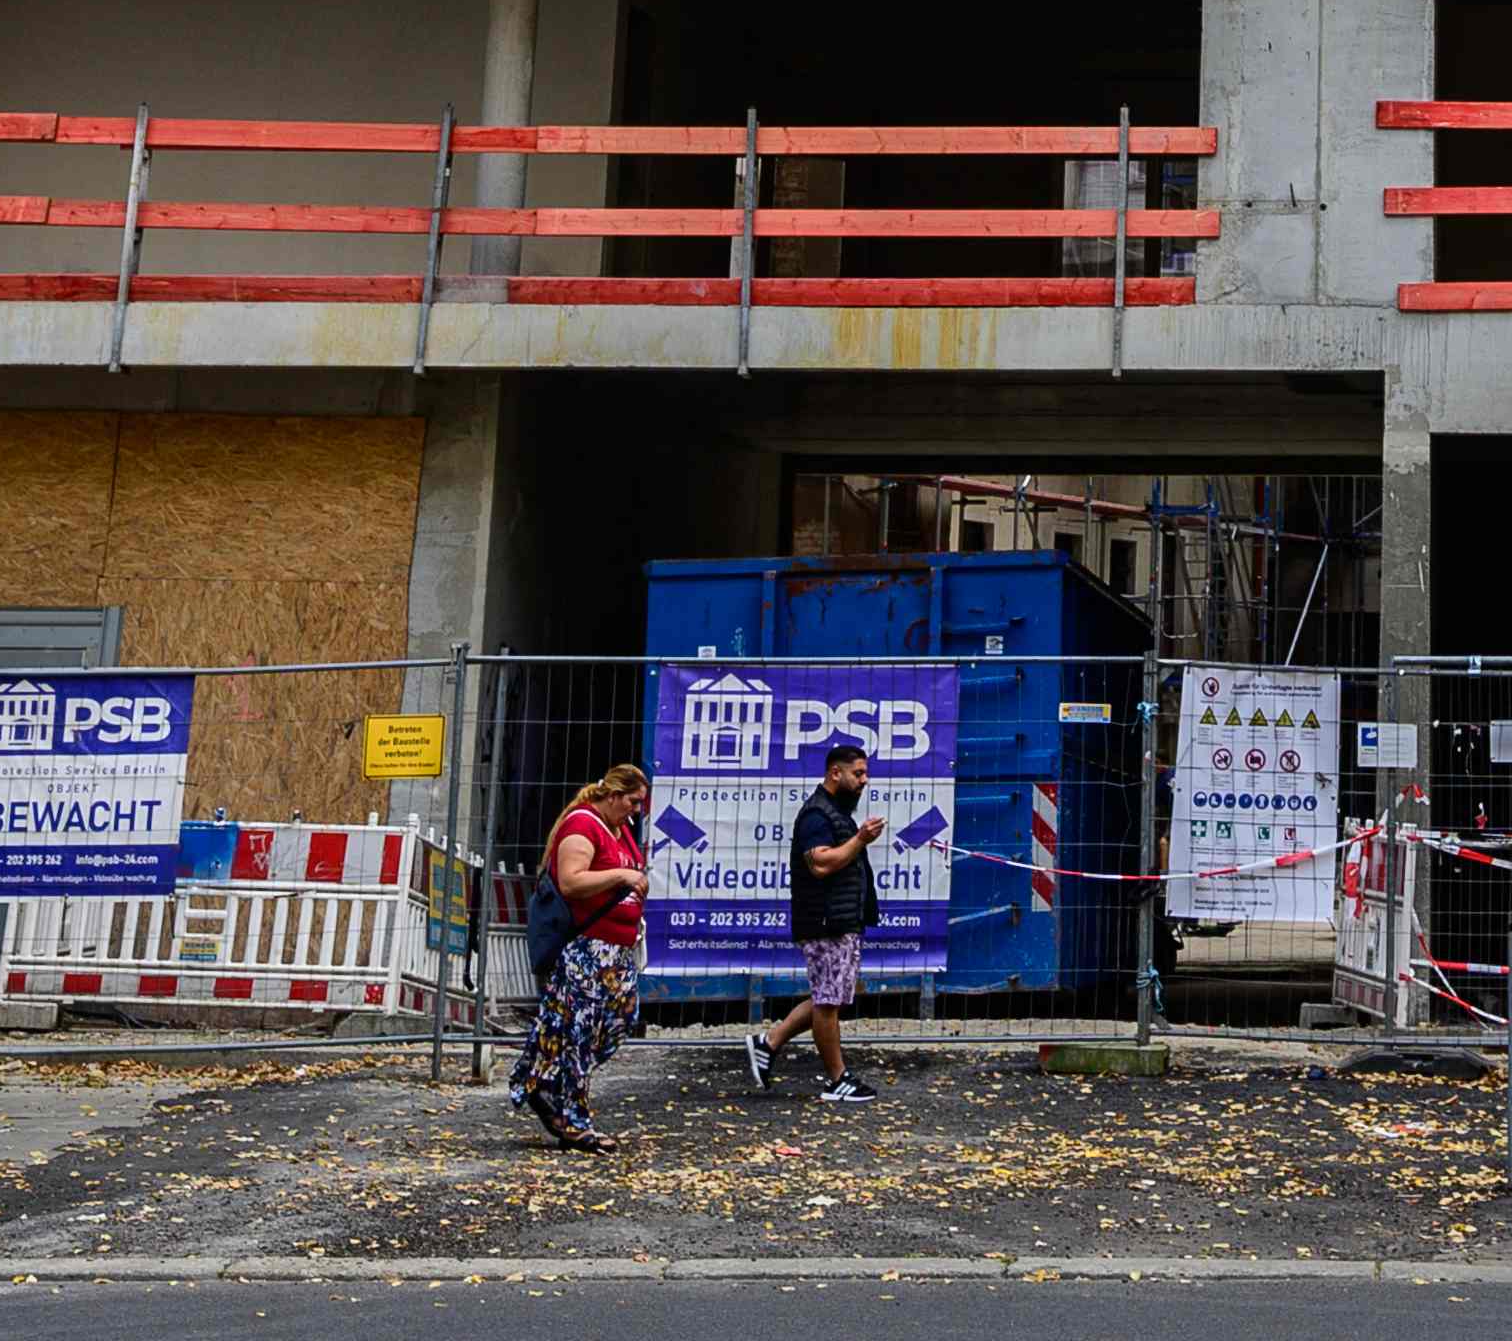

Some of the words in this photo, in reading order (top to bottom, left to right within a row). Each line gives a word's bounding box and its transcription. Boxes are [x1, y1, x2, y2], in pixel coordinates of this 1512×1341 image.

[63, 697, 172, 743] PSB
[784, 699, 931, 760] PSB
[66, 766, 116, 776] Service
[123, 765, 166, 775] Berlin
[47, 784, 99, 793] OBJEKT
[679, 789, 778, 802] Protection
[871, 790, 926, 802] Berlin
[6, 855, 23, 866] 202
[44, 855, 62, 866] 262
[675, 862, 922, 890] Videoübcht
[670, 913, 694, 926] 030
[709, 913, 734, 926] 202
[736, 913, 760, 926] 395
[763, 913, 786, 926] 262
